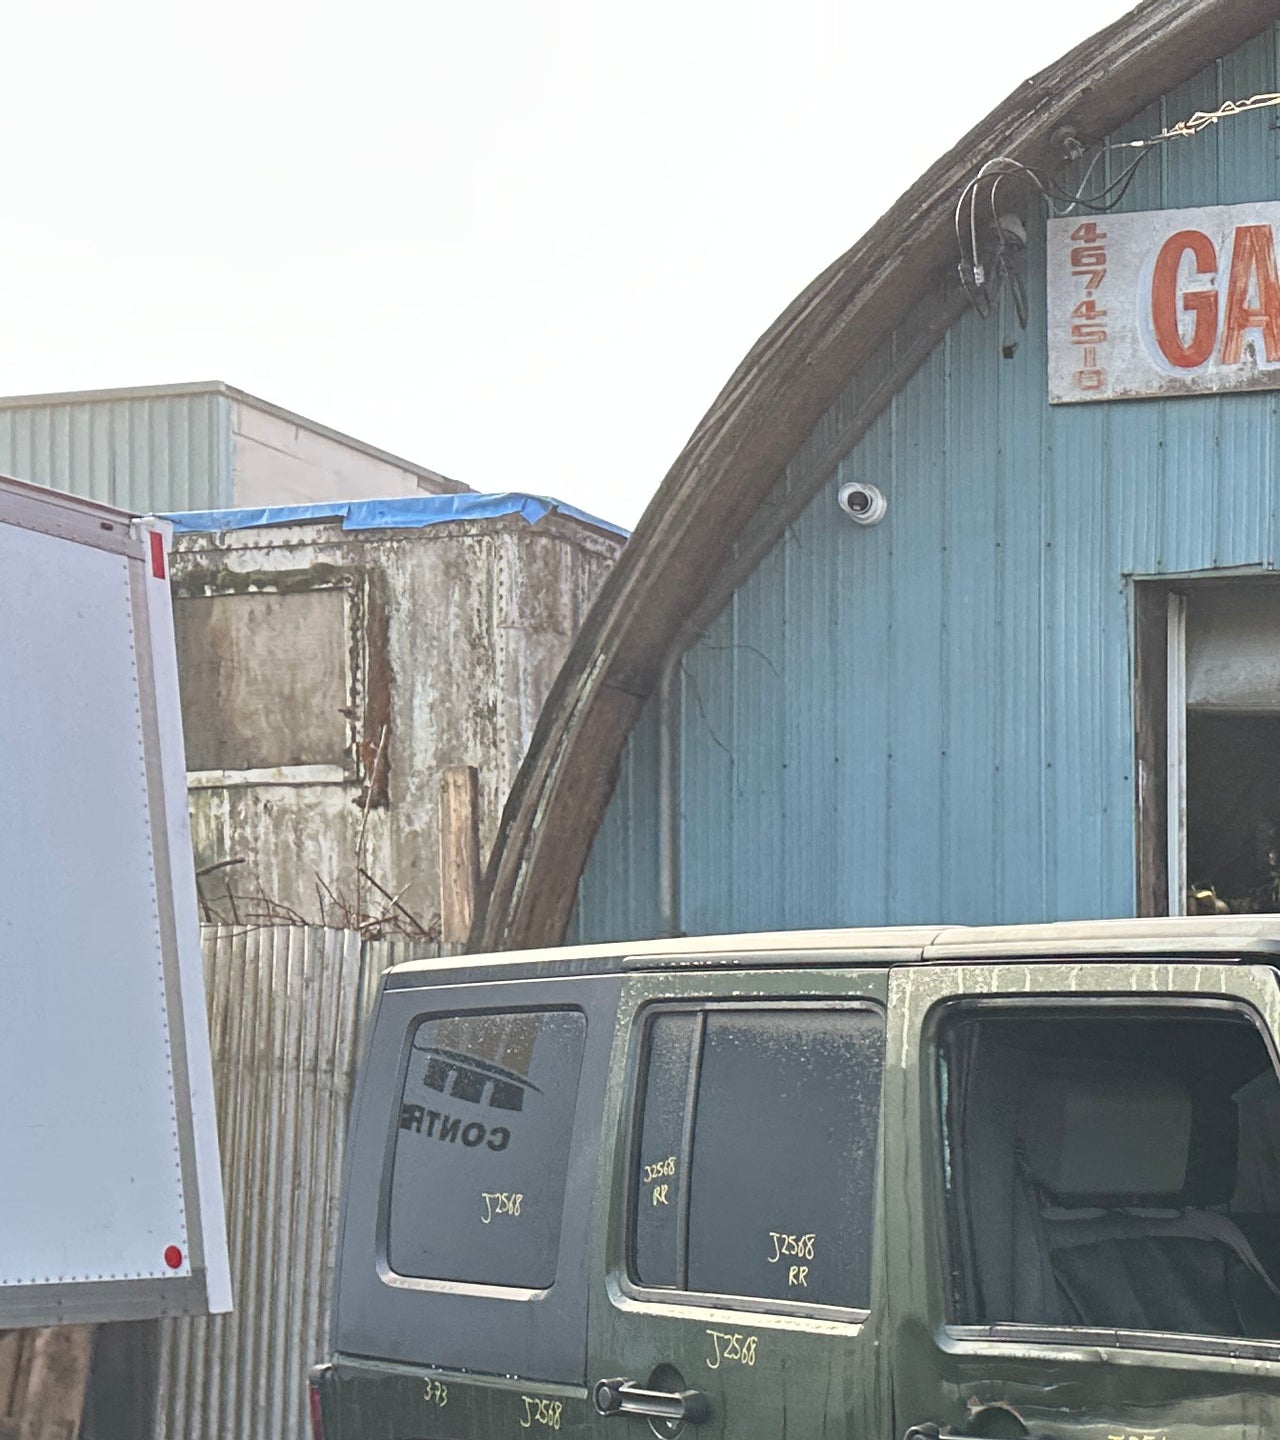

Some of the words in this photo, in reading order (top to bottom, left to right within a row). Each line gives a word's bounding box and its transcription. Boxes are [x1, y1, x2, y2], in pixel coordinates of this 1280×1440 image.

[644, 1156, 676, 1183] J2568
[481, 1192, 523, 1224] J2568
[652, 1185, 669, 1206] RR
[768, 1232, 815, 1263] J2568
[788, 1265, 808, 1287] RR
[706, 1329, 757, 1369] J2568
[520, 1397, 562, 1430] J2568
